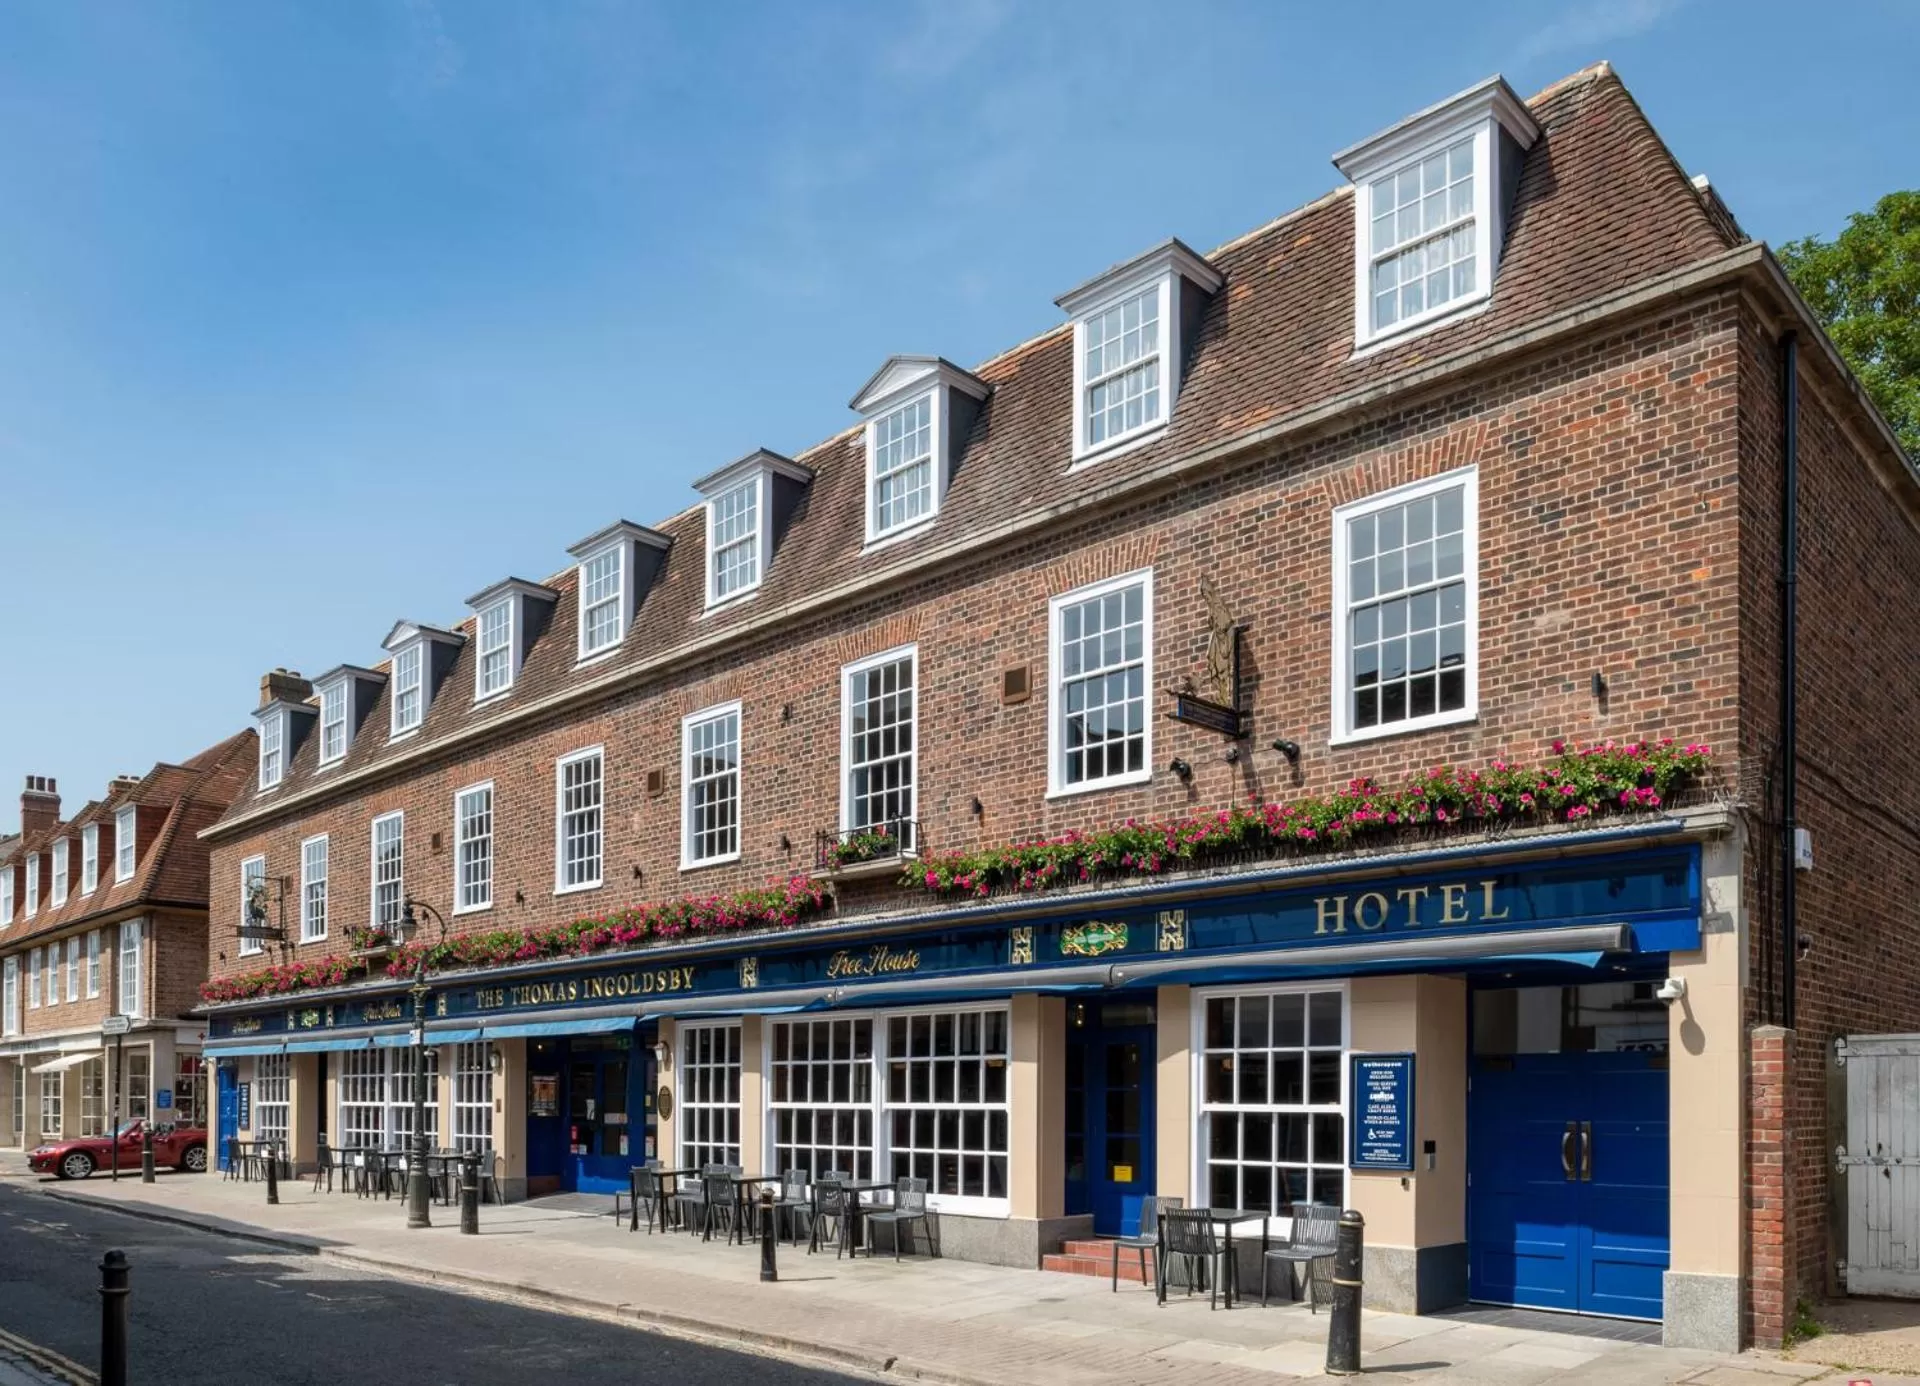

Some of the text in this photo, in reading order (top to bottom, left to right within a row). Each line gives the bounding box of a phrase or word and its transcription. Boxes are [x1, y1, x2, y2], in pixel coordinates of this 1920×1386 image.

[1314, 880, 1509, 934] HOTEL
[827, 944, 920, 979] Free House
[476, 966, 695, 1009] THE THOMAS INGOLDSBY
